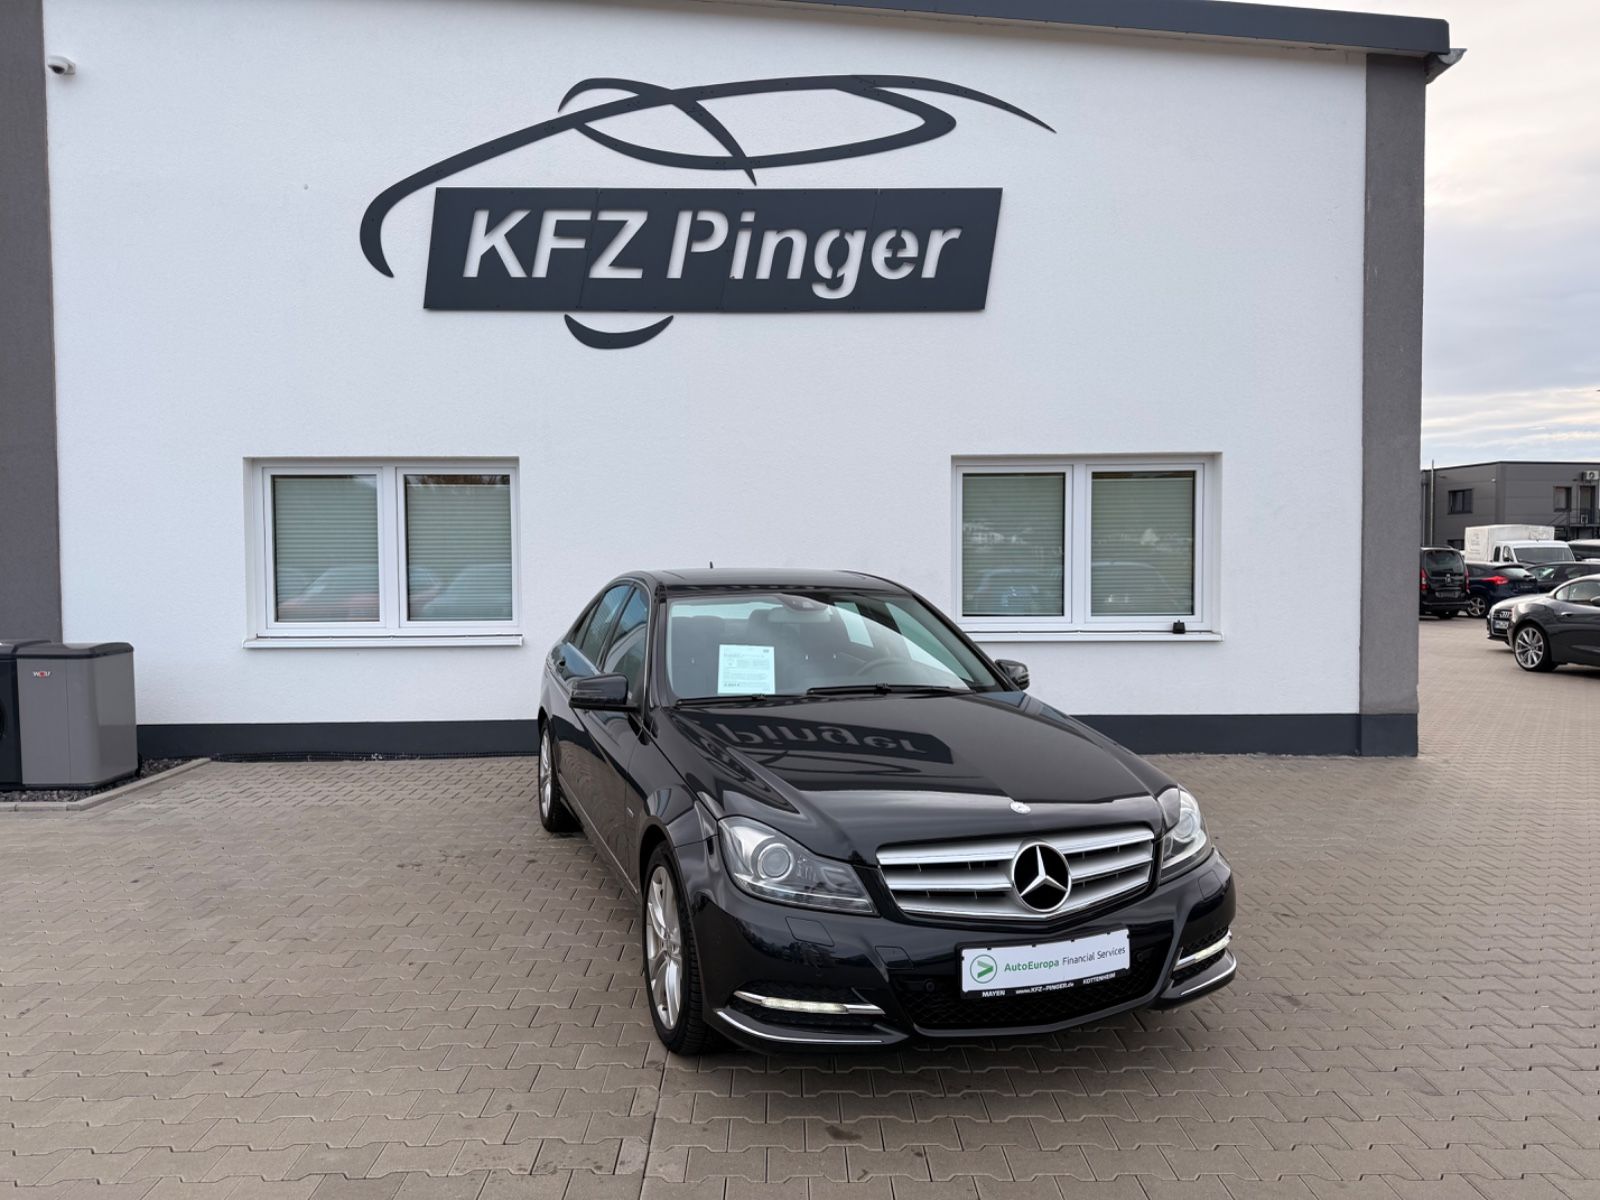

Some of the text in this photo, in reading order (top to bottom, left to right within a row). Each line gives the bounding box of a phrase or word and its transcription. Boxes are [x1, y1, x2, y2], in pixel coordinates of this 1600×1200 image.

[462, 209, 962, 299] KFZ Pinger
[1004, 946, 1126, 972] AutoEuropa Financial Services
[982, 990, 1006, 998] MAYEN
[1082, 972, 1116, 985] KOTTENHEIM
